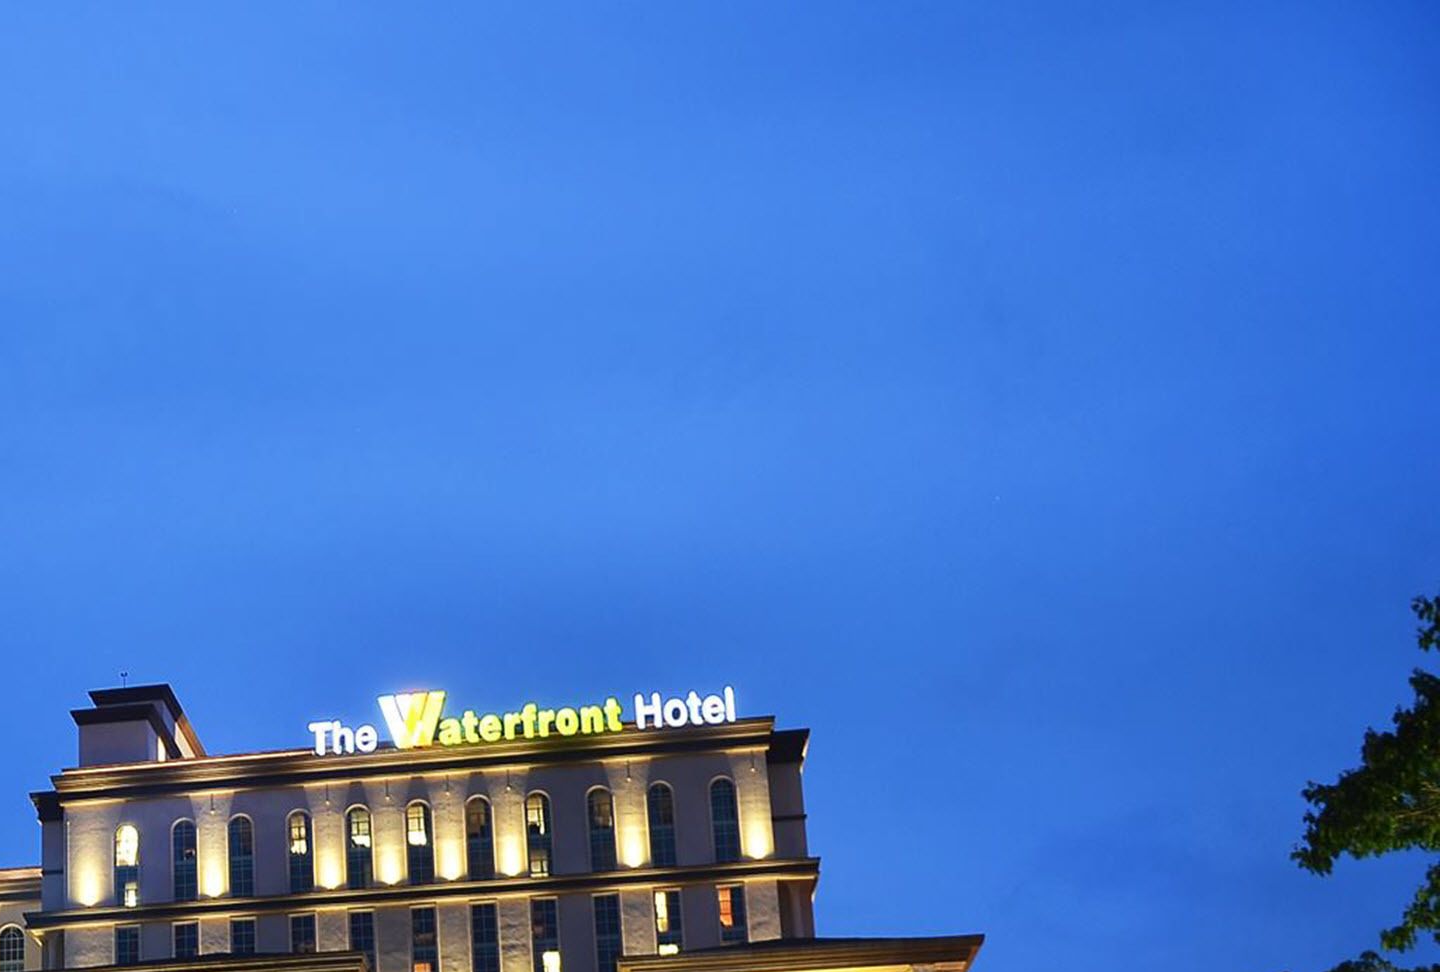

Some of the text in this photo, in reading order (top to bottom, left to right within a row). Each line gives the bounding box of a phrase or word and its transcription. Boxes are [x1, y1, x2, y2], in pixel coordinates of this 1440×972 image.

[308, 686, 736, 756] The Waterfront Hotel
